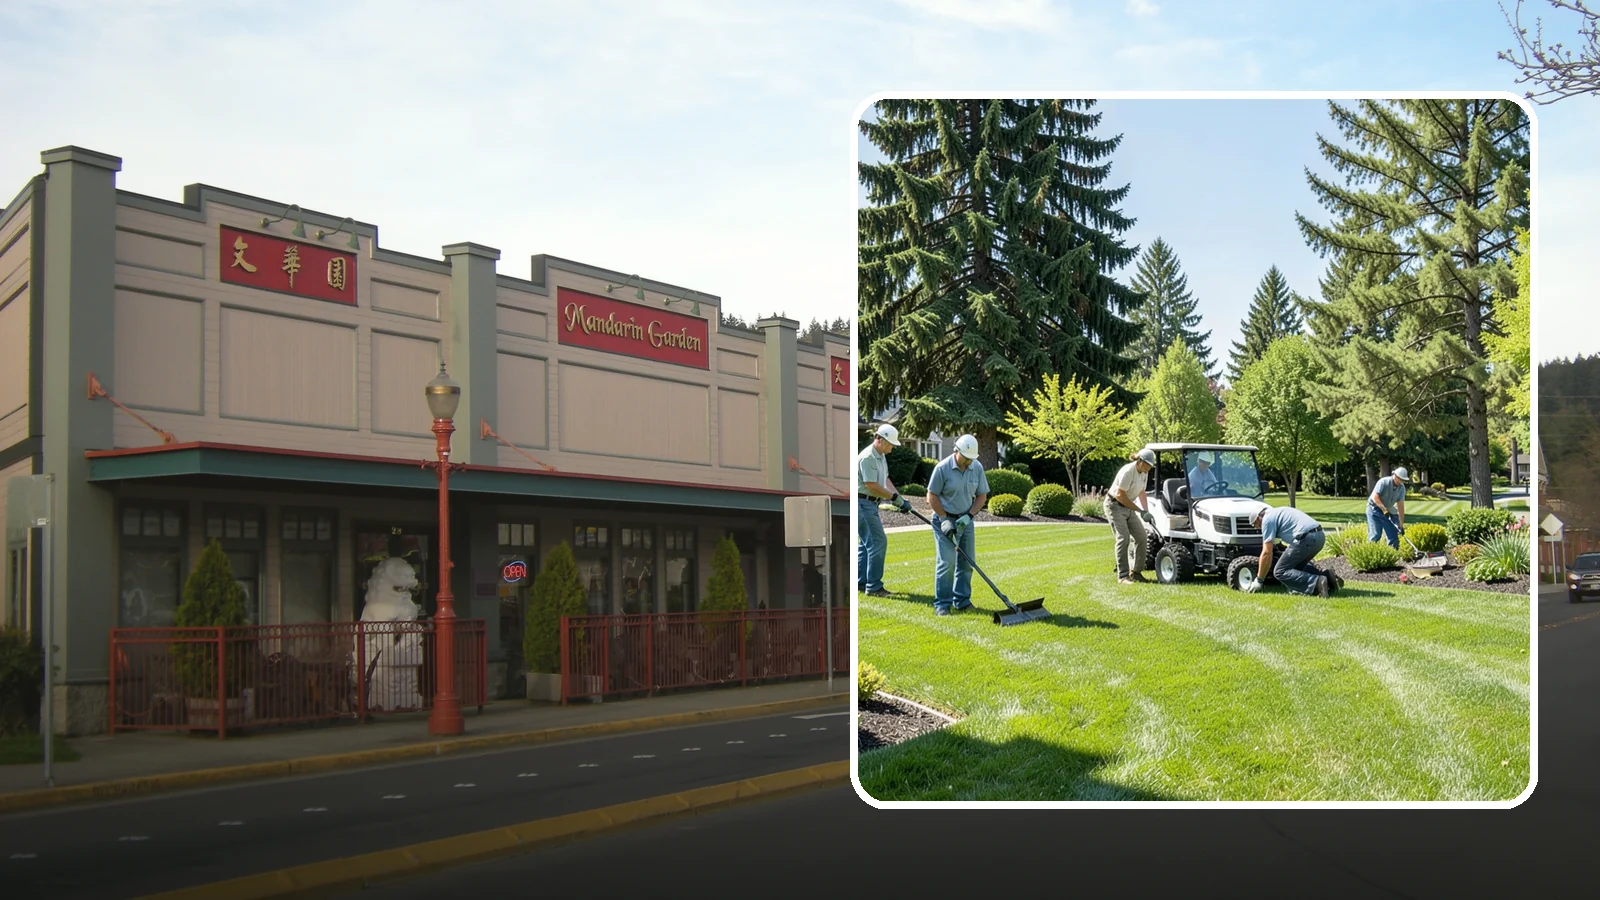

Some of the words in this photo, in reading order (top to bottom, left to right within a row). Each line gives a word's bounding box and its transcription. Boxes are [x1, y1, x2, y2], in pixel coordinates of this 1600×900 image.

[231, 236, 346, 291] 文華園
[564, 302, 644, 341] Mandarin
[648, 320, 701, 352] Garden
[503, 565, 527, 578] OPEN
